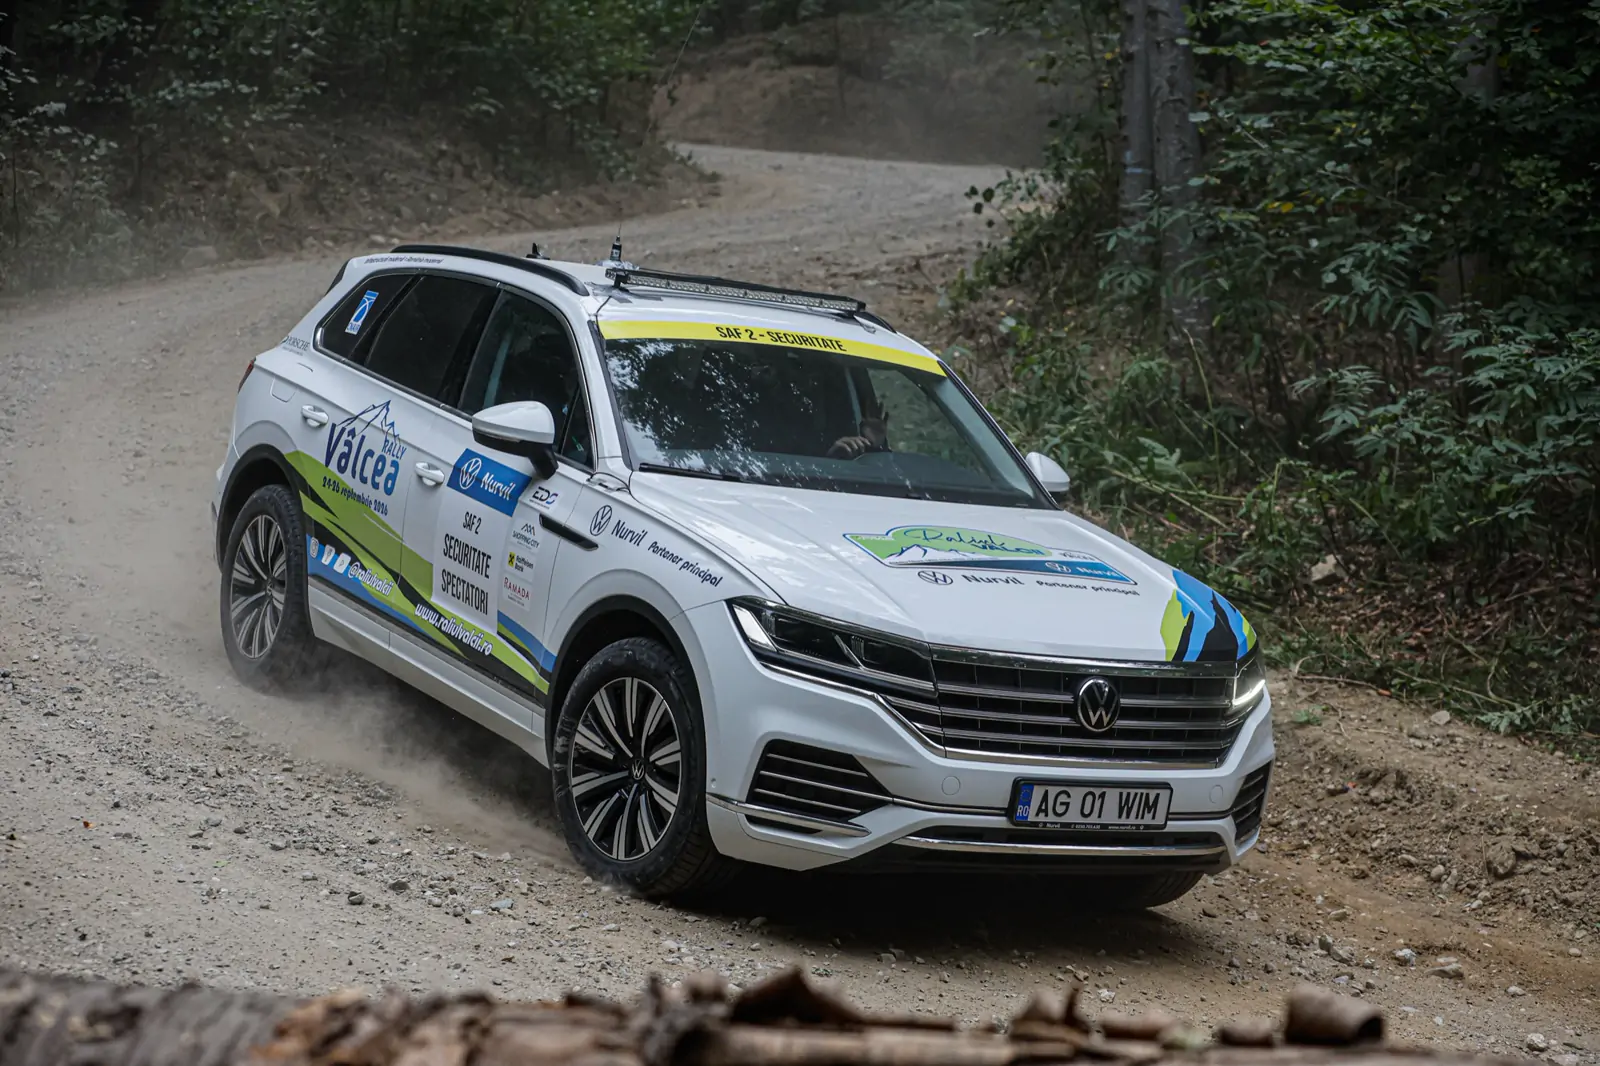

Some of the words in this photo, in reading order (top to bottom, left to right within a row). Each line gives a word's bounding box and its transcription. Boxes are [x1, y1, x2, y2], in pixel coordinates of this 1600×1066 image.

[716, 326, 742, 339] SAF
[745, 328, 758, 340] 2
[766, 331, 847, 352] SECURITATE
[381, 439, 407, 460] RALLY
[480, 472, 516, 501] Nurvil
[463, 511, 477, 531] SAF
[474, 516, 482, 535] 2
[443, 533, 492, 579] SECURITATE
[611, 520, 648, 547] Nurvil
[648, 541, 682, 566] Partener
[679, 562, 723, 588] principal
[441, 568, 489, 615] SPECTATORI
[503, 577, 530, 600] RAMADA
[961, 574, 1025, 586] Nurvil
[414, 603, 493, 656] www.raliulvalcii.ro
[1016, 804, 1029, 817] RO
[1035, 789, 1072, 818] AG
[1079, 790, 1107, 819] 01
[1117, 791, 1161, 820] WIM
